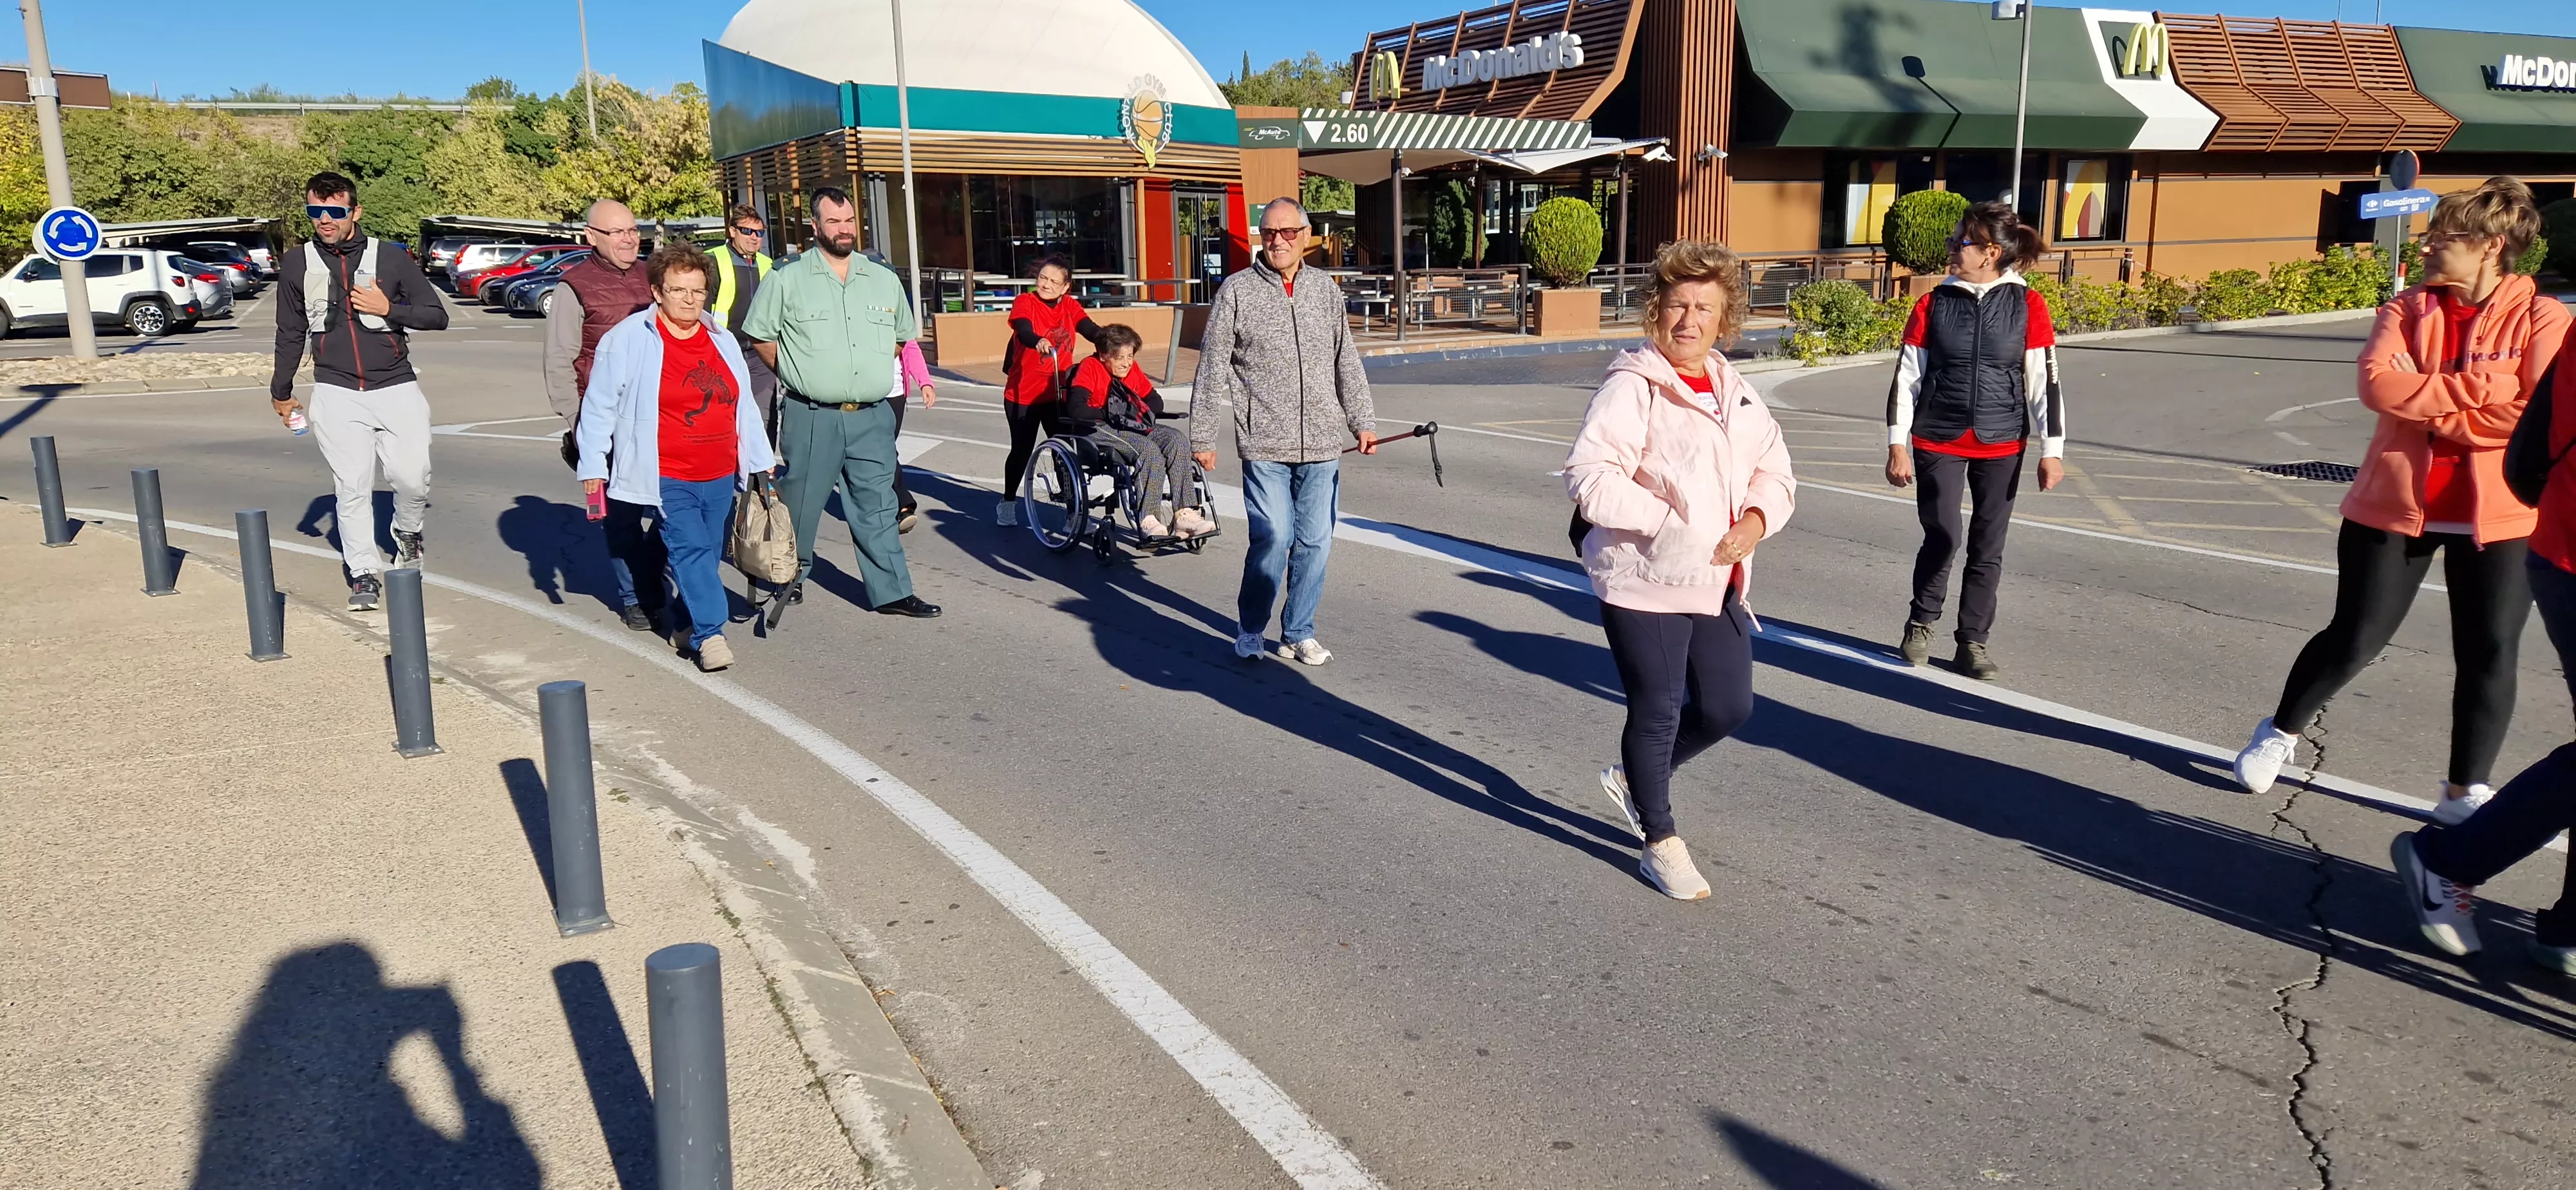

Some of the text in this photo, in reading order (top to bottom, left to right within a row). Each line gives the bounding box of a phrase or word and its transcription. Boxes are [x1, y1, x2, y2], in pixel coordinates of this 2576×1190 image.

[1421, 30, 1584, 91] McDonald's
[1144, 73, 1167, 99] GYM
[1162, 102, 1173, 144] CLUB
[1331, 123, 1368, 143] 2.60
[2383, 196, 2425, 207] Gasolinera
